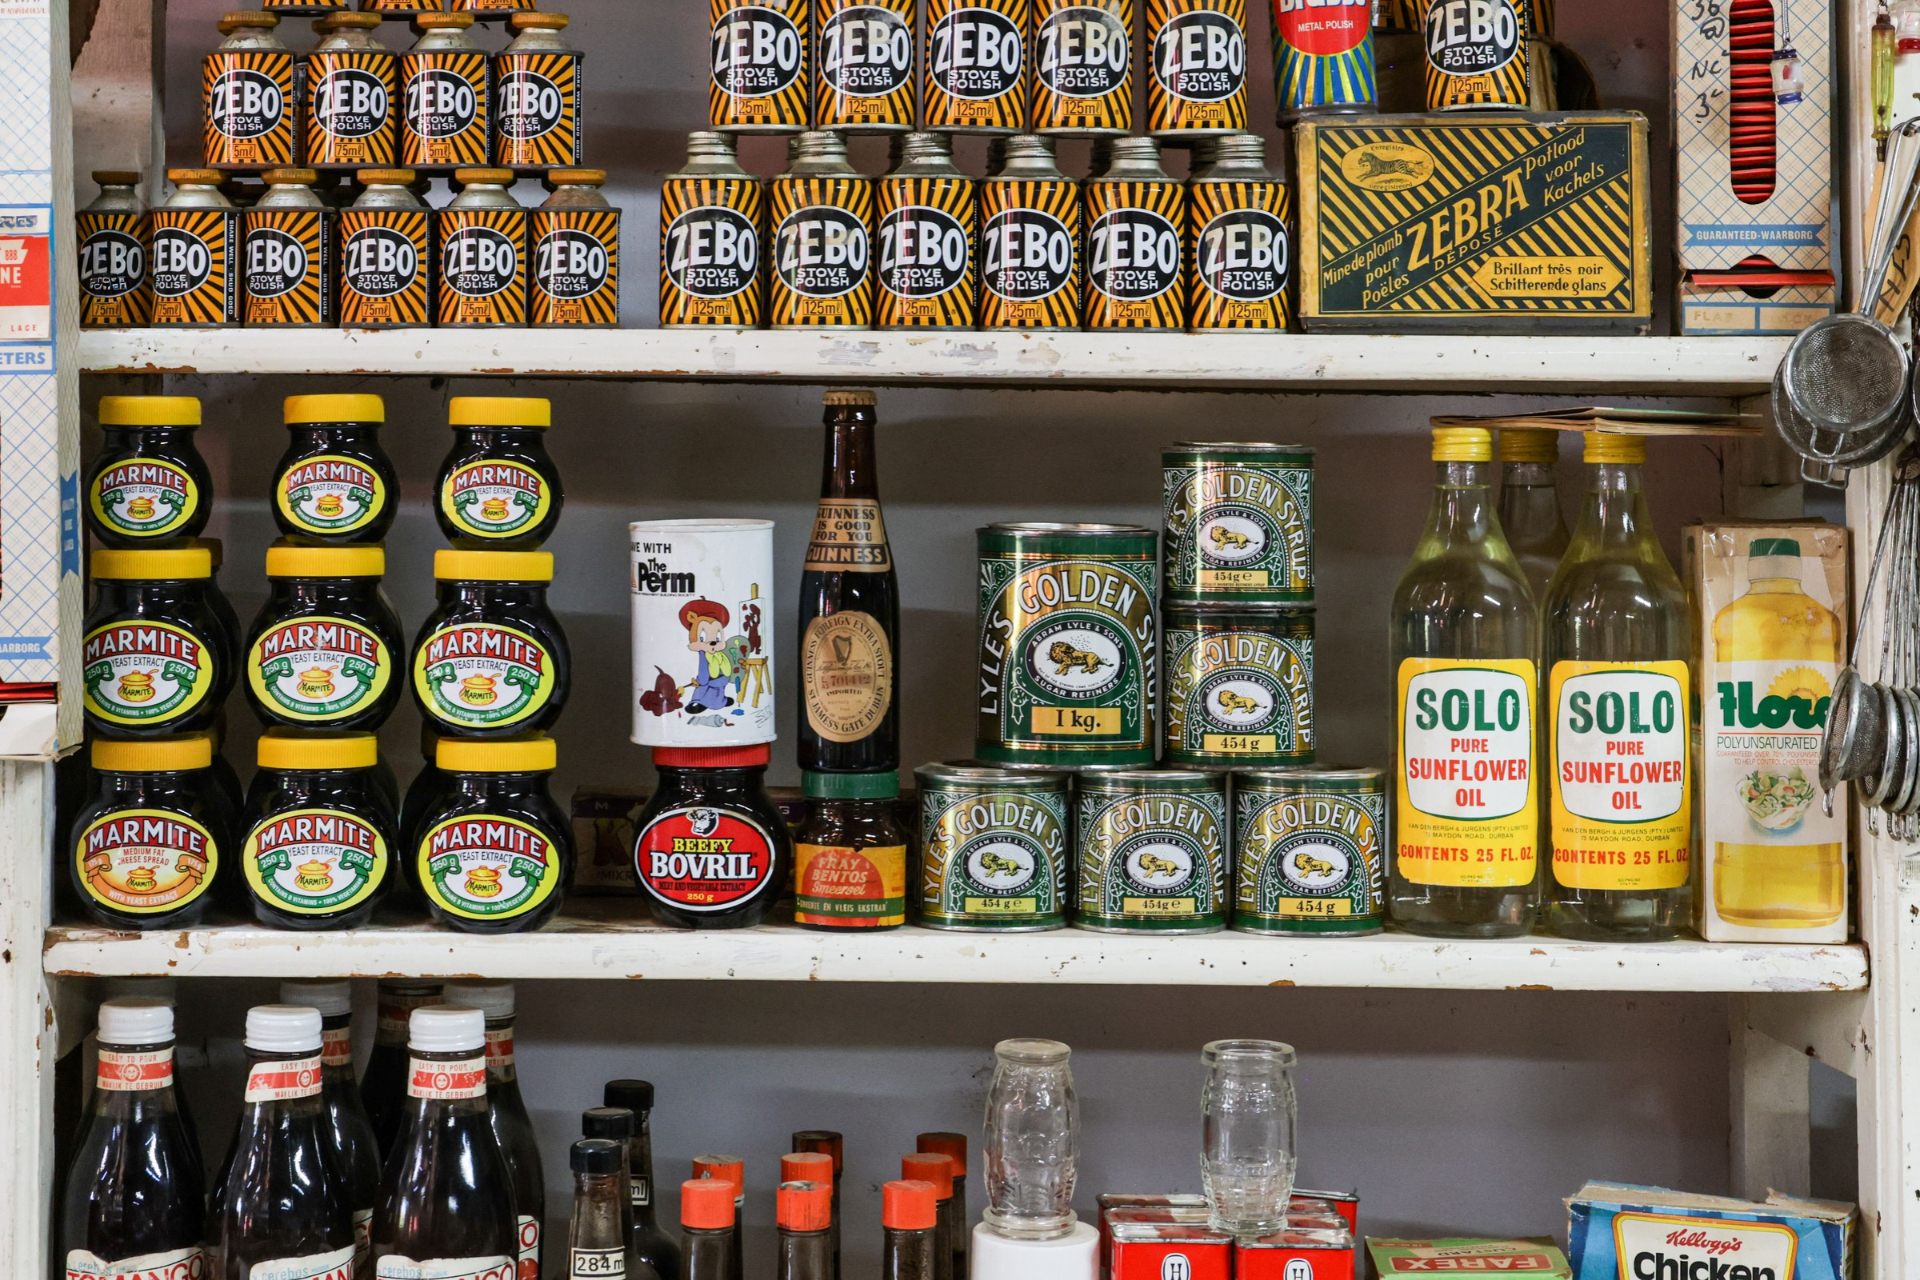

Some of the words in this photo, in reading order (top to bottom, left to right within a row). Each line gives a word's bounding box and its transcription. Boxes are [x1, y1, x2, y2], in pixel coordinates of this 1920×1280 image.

[1298, 20, 1323, 32] METAL
[1325, 20, 1354, 30] POLISH
[1430, 2, 1515, 52] ZEBO
[715, 20, 797, 74] ZEBO
[826, 19, 909, 73] ZEBO
[936, 22, 1019, 75] ZEBO
[1042, 20, 1125, 74] ZEBO
[1161, 25, 1245, 79] ZEBO
[726, 76, 779, 87] POLISH
[727, 68, 776, 77] STOVE
[214, 80, 278, 120] ZEBO
[319, 79, 386, 119] ZEBO
[408, 80, 472, 120] ZEBO
[498, 81, 559, 120] ZEBO
[331, 115, 370, 123] STOVE
[331, 122, 371, 130] POLISH
[1525, 127, 1585, 180] Potlood
[1545, 156, 1582, 182] voor
[1544, 164, 1604, 206] Kachels
[1406, 168, 1530, 272] ZEBRA
[671, 220, 756, 273] ZEBO
[781, 220, 863, 272] ZEBO
[880, 220, 965, 273] ZEBO
[1696, 230, 1813, 240] GUARANTEED-WAARBORG
[80, 241, 143, 280] ZEBO
[246, 238, 301, 277] ZEBO
[348, 238, 413, 278] ZEBO
[447, 237, 513, 278] ZEBO
[538, 240, 605, 280] ZEBO
[985, 223, 1069, 276] ZEBO
[1091, 223, 1179, 275] ZEBO
[1205, 223, 1288, 276] ZEBO
[1323, 262, 1350, 288] Mine
[1350, 250, 1367, 272] de
[1366, 229, 1404, 267] plomb
[685, 276, 739, 287] POLISH
[687, 268, 737, 278] STOVE
[1365, 256, 1400, 287] pour
[1493, 262, 1543, 275] Brillant
[1547, 262, 1572, 275] très
[1577, 264, 1604, 275] noir
[1362, 273, 1410, 310] Poëles
[1490, 276, 1570, 293] Schitterende
[1572, 277, 1607, 296] glans
[694, 300, 730, 315] 125ml
[11, 324, 37, 332] LACE
[102, 466, 183, 490] MARMITE
[290, 463, 372, 488] MARMITE
[456, 466, 537, 492] MARMITE
[1185, 474, 1279, 508] GOLDEN
[817, 508, 875, 520] GUINNESS
[818, 521, 826, 530] IS
[835, 521, 871, 530] GOOD
[643, 542, 672, 554] WITH
[815, 531, 837, 541] FOR
[847, 531, 872, 541] YOU
[648, 557, 667, 573] The
[807, 545, 883, 562] GUINNESS
[638, 562, 695, 593] Perm
[86, 628, 194, 661] MARMITE
[264, 624, 373, 658] MARMITE
[429, 631, 537, 667] MARMITE
[981, 610, 1014, 715] LYLE'S
[1018, 570, 1137, 618] GOLDEN
[1032, 624, 1063, 647] ABRAM
[1068, 622, 1091, 631] LYLE
[1095, 624, 1101, 632] &
[1103, 628, 1123, 649] SONS
[290, 653, 312, 664] YEAST
[314, 652, 345, 664] EXTRACT
[853, 619, 876, 647] EXTRA
[875, 648, 886, 680] STOUT
[1191, 638, 1287, 673] GOLDEN
[349, 659, 366, 671] 250
[1034, 675, 1067, 698] SUGAR
[1071, 677, 1120, 699] REFINERS
[842, 717, 867, 732] GATE
[867, 686, 884, 721] DUBLIN
[1071, 708, 1101, 732] kg.
[1415, 688, 1521, 732] SOLO
[1569, 690, 1675, 734] SOLO
[1450, 738, 1489, 753] PURE
[1606, 741, 1644, 756] PURE
[1717, 736, 1818, 750] POLYUNSATURATED
[1409, 757, 1527, 782] SUNFLOWER
[1562, 760, 1682, 784] SUNFLOWER
[1455, 788, 1486, 807] OIL
[1612, 791, 1642, 810] OIL
[955, 802, 1049, 836] GOLDEN
[89, 819, 202, 854] MARMITE
[261, 816, 371, 850] MARMITE
[432, 823, 542, 857] MARMITE
[673, 838, 733, 853] BEEFY
[123, 848, 152, 856] MEDIUM
[153, 849, 165, 857] FAT
[143, 855, 169, 865] SPREAD
[459, 851, 479, 862] YEAST
[481, 851, 513, 863] EXTRACT
[650, 852, 757, 879] BOVRIL
[818, 856, 861, 870] FRAY
[1083, 827, 1113, 903] LYLE'S
[1110, 801, 1205, 834] GOLDEN
[1202, 826, 1224, 904] SYRUP
[1240, 826, 1269, 903] LYLE'S
[1266, 801, 1362, 835] GOLDEN
[1358, 826, 1383, 905] SYRUP
[1400, 844, 1469, 862] CONTENTS
[1476, 848, 1494, 863] 25
[1501, 848, 1518, 862] FL.
[1520, 846, 1534, 861] OZ.
[811, 869, 868, 883] BENTOS
[127, 895, 147, 905] YEAST
[687, 893, 704, 901] 250
[707, 894, 714, 902] g
[823, 903, 831, 911] EN
[835, 904, 854, 912] VLEIS
[1296, 901, 1323, 913] 454
[108, 1053, 123, 1062] EASY
[127, 1055, 135, 1063] TO
[1666, 1228, 1743, 1255] Kellogg's
[577, 1256, 611, 1272] 284
[1406, 1256, 1538, 1270] FAREX
[1633, 1252, 1776, 1280] Chicken
